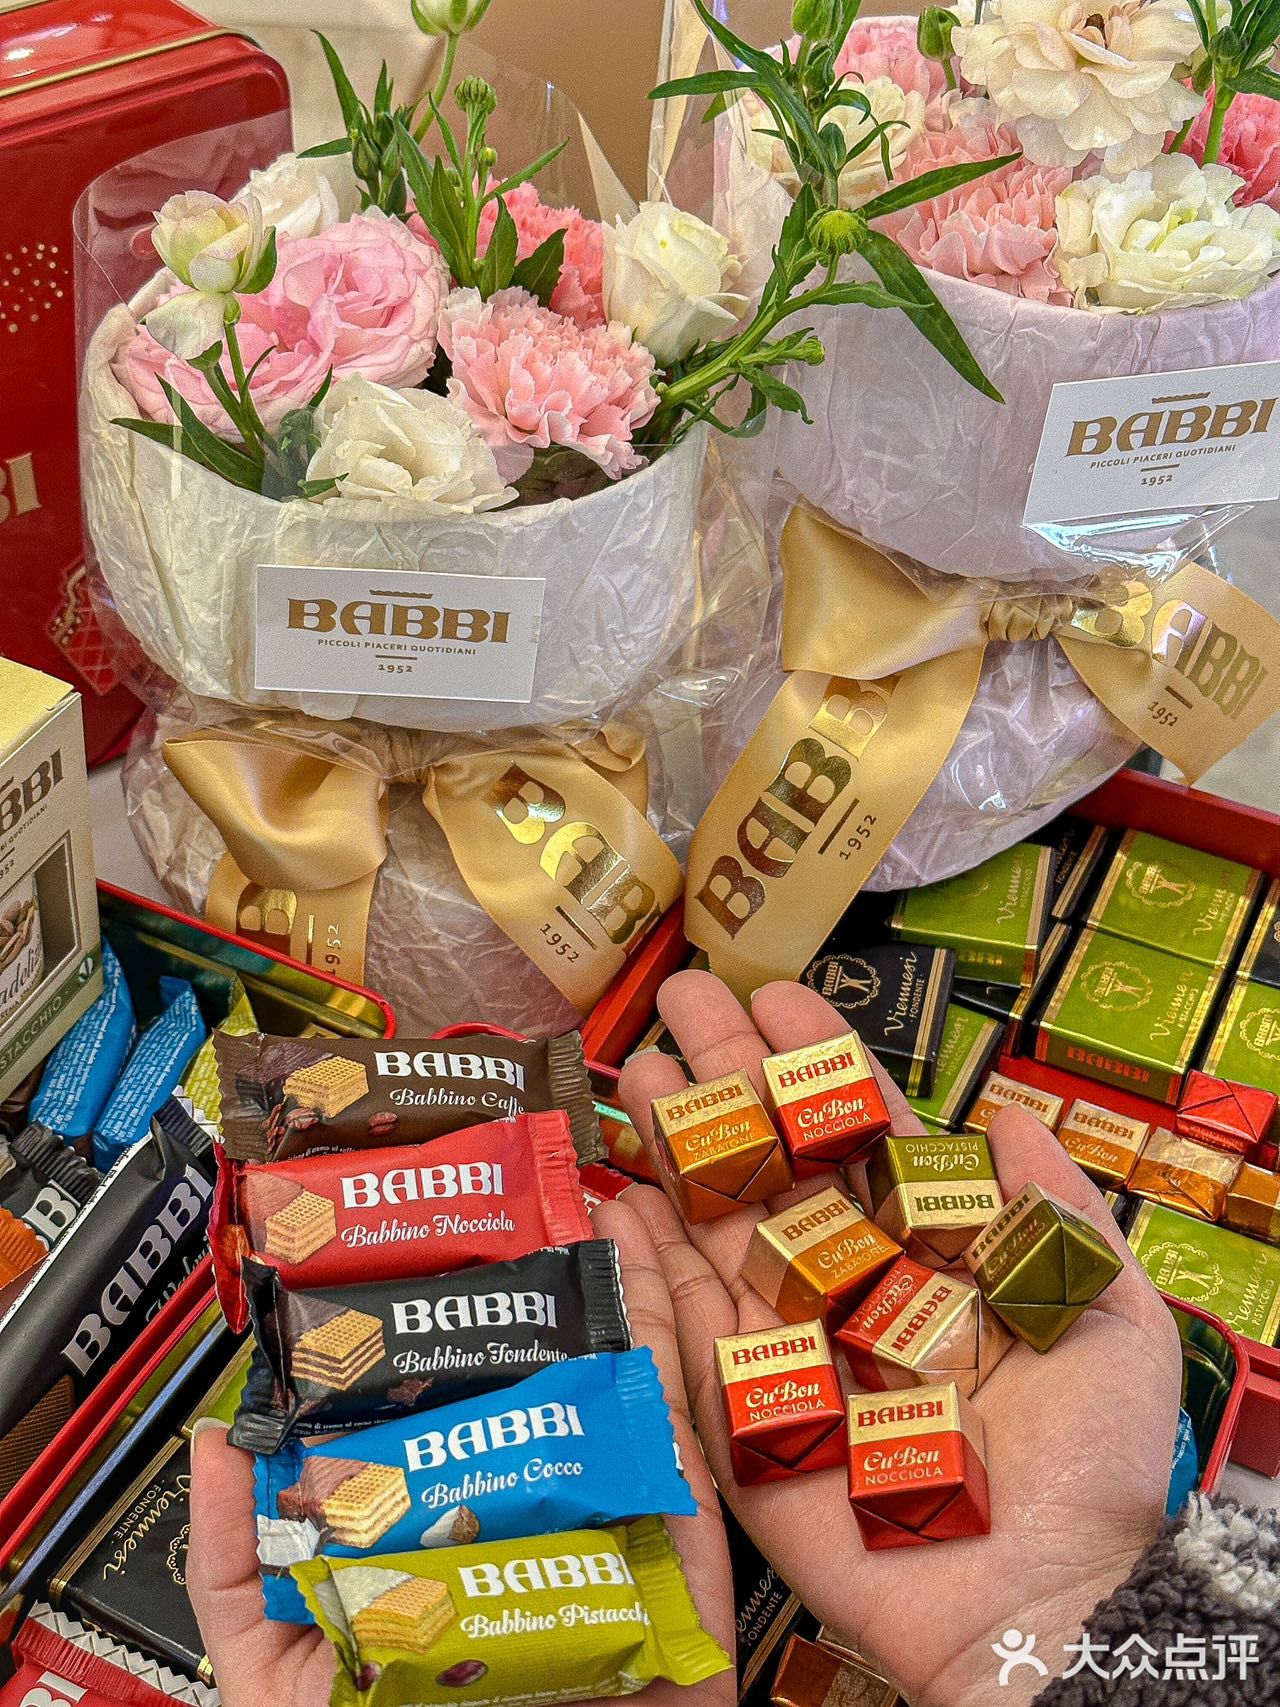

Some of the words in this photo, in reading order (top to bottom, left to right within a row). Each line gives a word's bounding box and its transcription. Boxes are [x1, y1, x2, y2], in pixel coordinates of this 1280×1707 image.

[1065, 397, 1279, 457] BABBI
[1090, 458, 1130, 469] PICCOLI
[1133, 452, 1172, 464] PIACERI
[1176, 444, 1236, 458] QUOTIDIANI
[1141, 475, 1173, 486] 1952
[287, 598, 511, 644] BABBI
[318, 638, 361, 648] PICCOLI
[365, 642, 407, 651] PIACERI
[411, 645, 476, 655] QUOTIDIANI
[378, 663, 413, 674] 1952
[1148, 701, 1179, 727] 1952
[481, 760, 660, 945] BAB
[839, 814, 878, 860] 1952
[540, 923, 579, 963] 1952
[884, 951, 918, 1036] Viennesi
[909, 977, 925, 1019] FONDENTE
[374, 1051, 526, 1093] BABBI
[778, 1052, 855, 1089] BABBI
[389, 1087, 476, 1106] Babbino
[666, 1084, 744, 1121] BABBI
[797, 1095, 865, 1129] CuBon
[685, 1119, 752, 1152] CuBon
[803, 1112, 873, 1141] NOCCIOLA
[906, 1142, 979, 1153] PISTACCHIO
[912, 1153, 980, 1172] CuBon
[340, 1161, 504, 1209] BABBI
[914, 1194, 995, 1212] BABBI
[341, 1220, 430, 1248] Babbino
[433, 1209, 516, 1237] Nocciola
[781, 1199, 850, 1242] BABBI
[971, 1194, 1030, 1259] BABBI
[817, 1231, 877, 1270] CuBon
[61, 1164, 214, 1376] BABBI
[391, 1291, 558, 1335] BABBI
[891, 1285, 953, 1352] BABBI
[392, 1346, 486, 1374] Babbino
[486, 1340, 568, 1365] Fondente
[732, 1336, 817, 1366] BABBI
[745, 1380, 821, 1408] CuBon
[750, 1398, 826, 1421] NOCCIOLA
[857, 1401, 944, 1428] BABBI
[404, 1402, 586, 1472] BABBI
[864, 1445, 940, 1472] CuBon
[865, 1465, 944, 1486] NOCCIOLA
[421, 1470, 519, 1509] Babbino
[524, 1457, 584, 1482] Cocco
[114, 1484, 162, 1539] FONDENTE
[458, 1552, 635, 1598] BABBI
[460, 1608, 558, 1639] Babbino
[742, 1591, 783, 1642] ONDENTE
